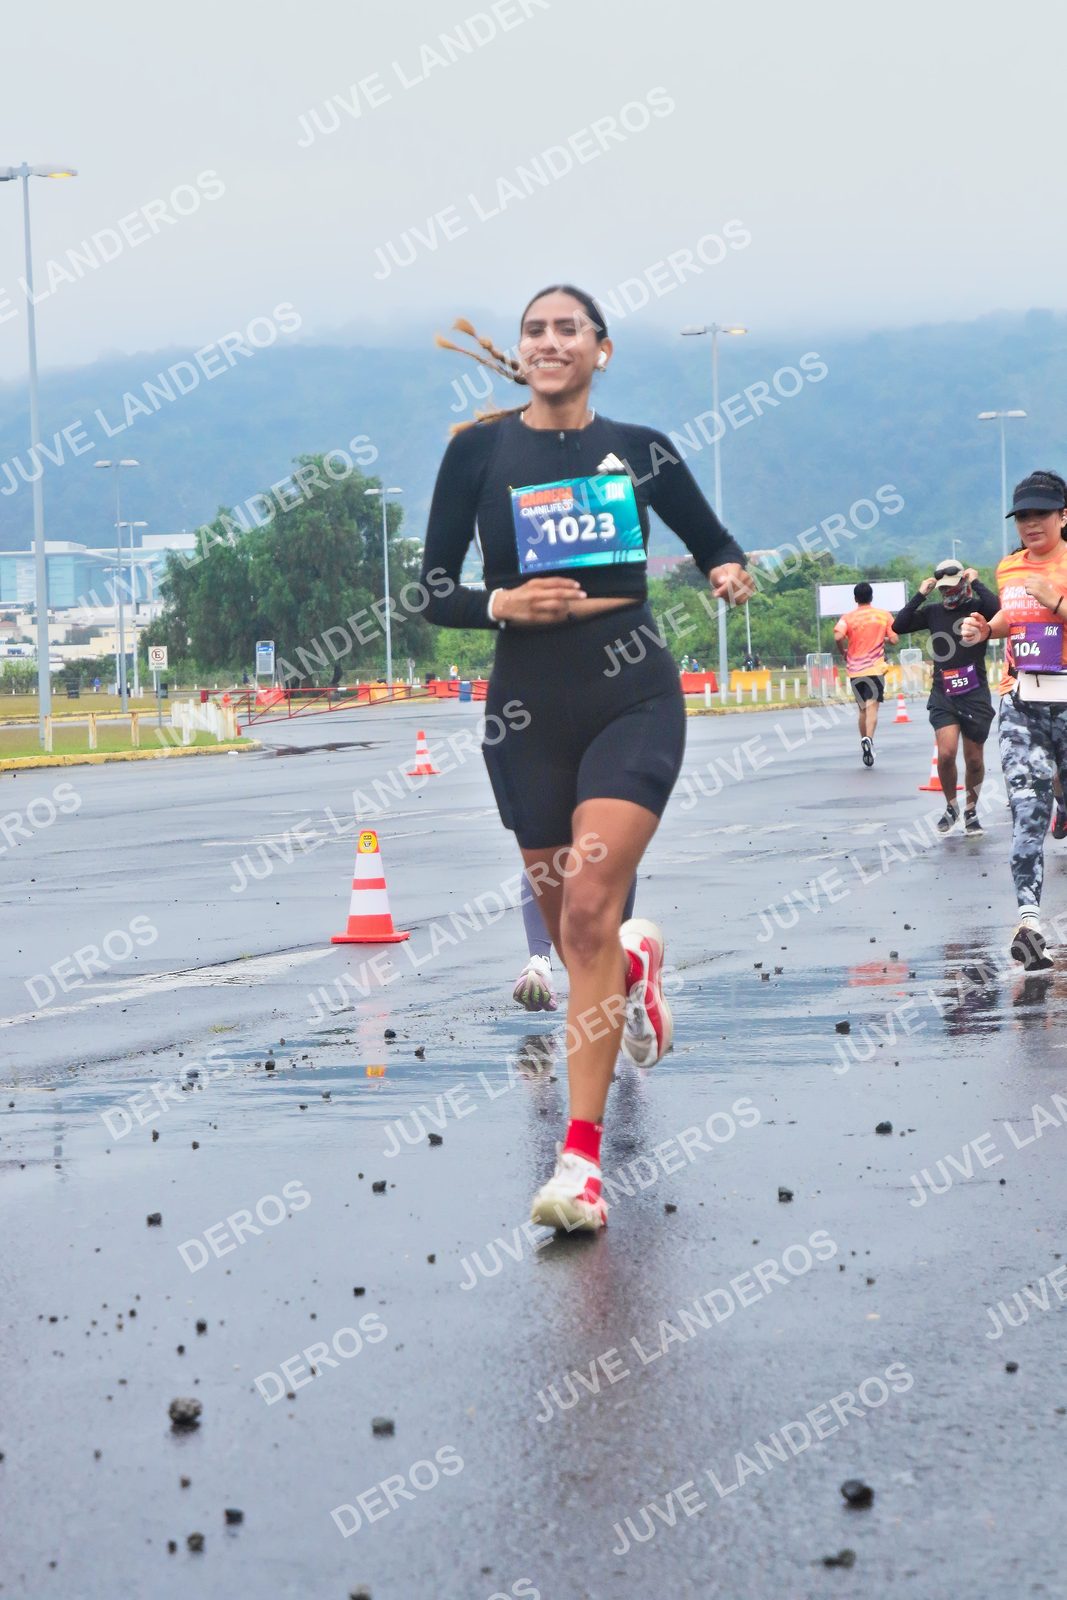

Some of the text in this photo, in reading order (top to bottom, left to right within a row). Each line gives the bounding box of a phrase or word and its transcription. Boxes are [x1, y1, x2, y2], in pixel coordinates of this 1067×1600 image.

[541, 512, 616, 545] 1023
[1013, 642, 1041, 657] 104
[951, 677, 969, 688] 553
